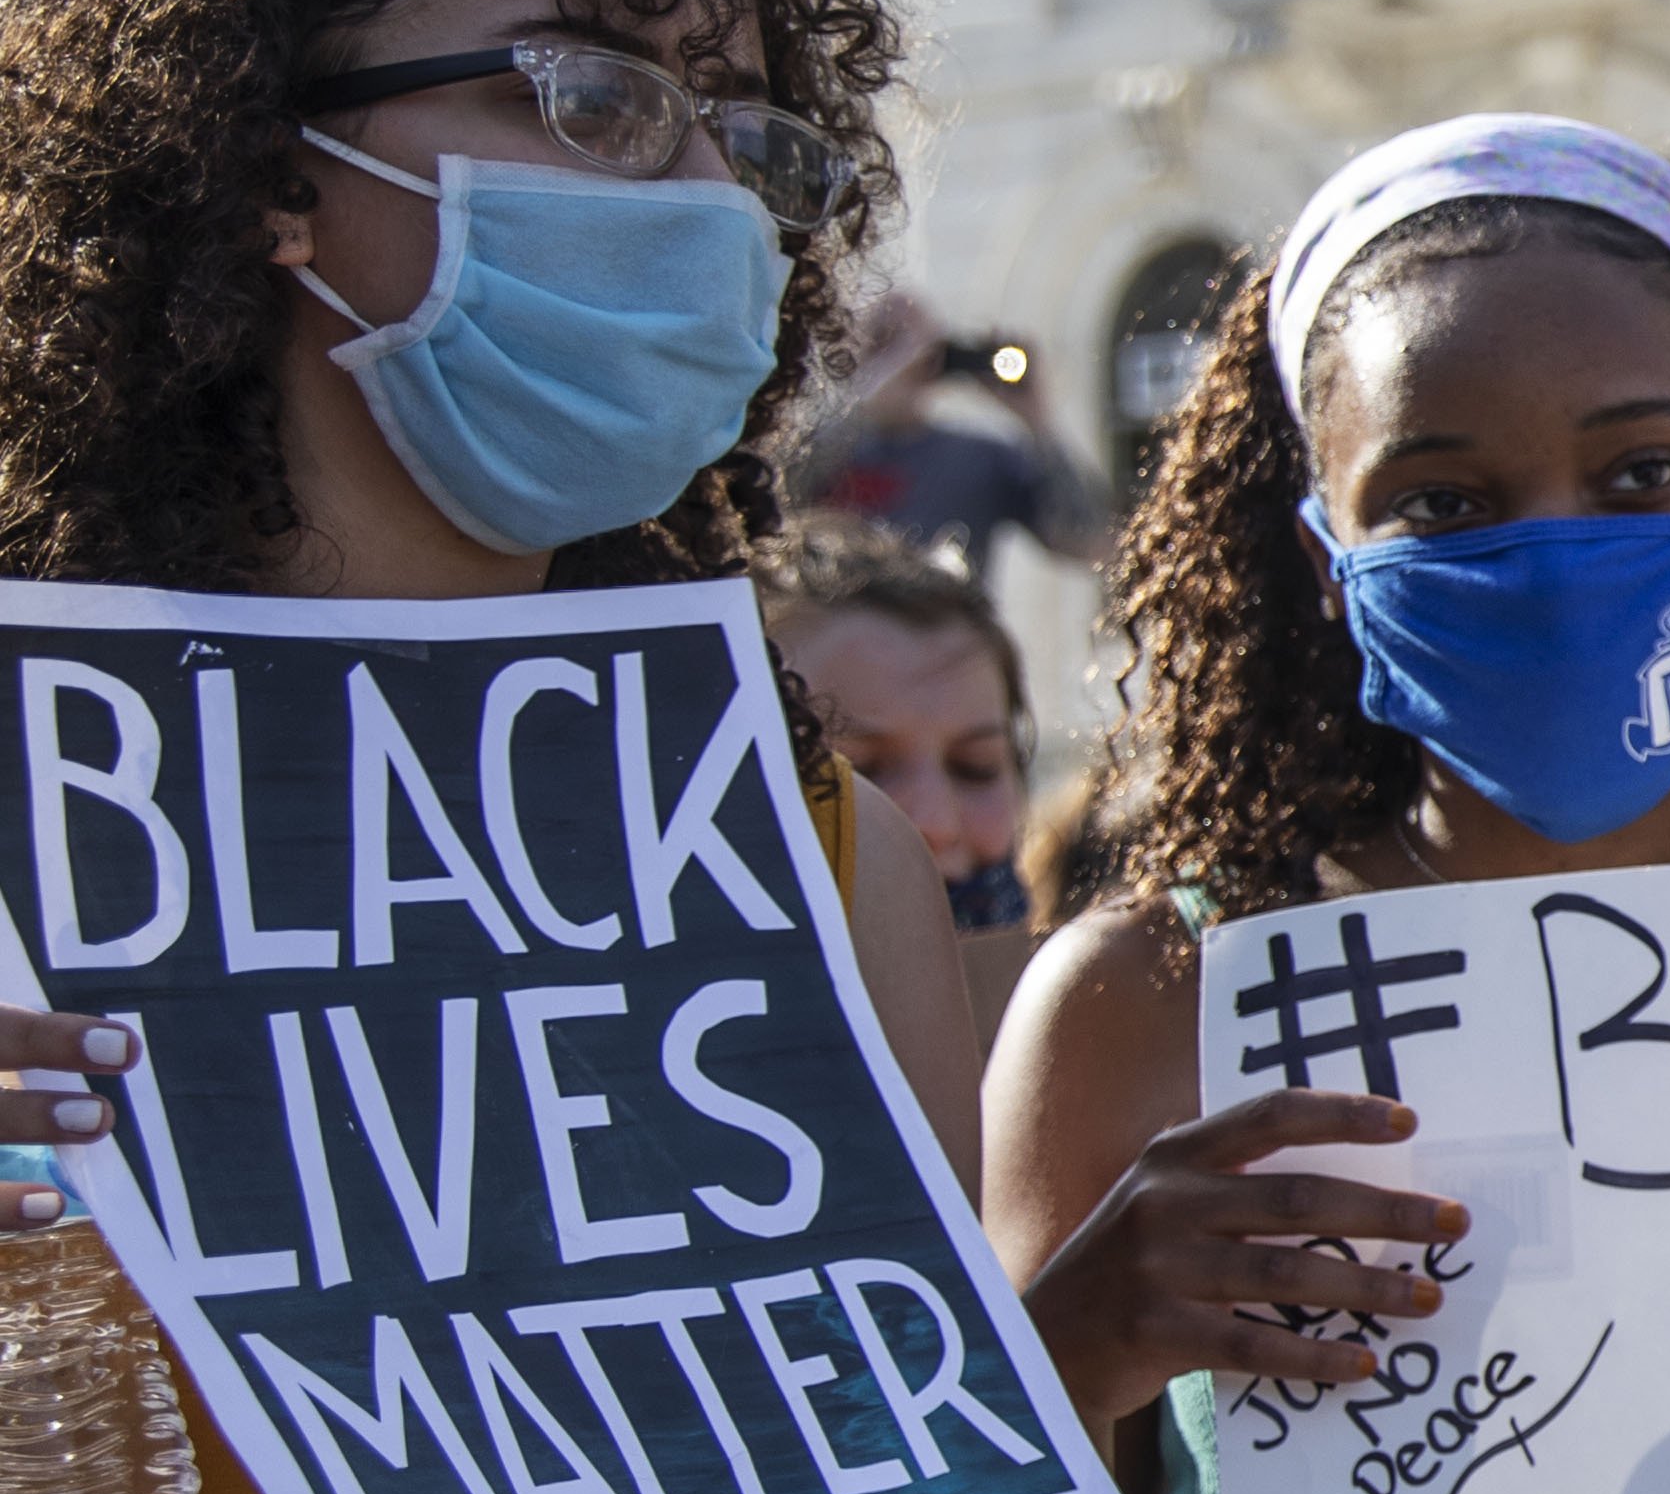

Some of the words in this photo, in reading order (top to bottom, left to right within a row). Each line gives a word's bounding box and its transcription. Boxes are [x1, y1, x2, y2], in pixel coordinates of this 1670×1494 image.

[22, 654, 796, 973] BLACK
[107, 979, 823, 1295] LIVES
[1345, 1341, 1440, 1447] NO
